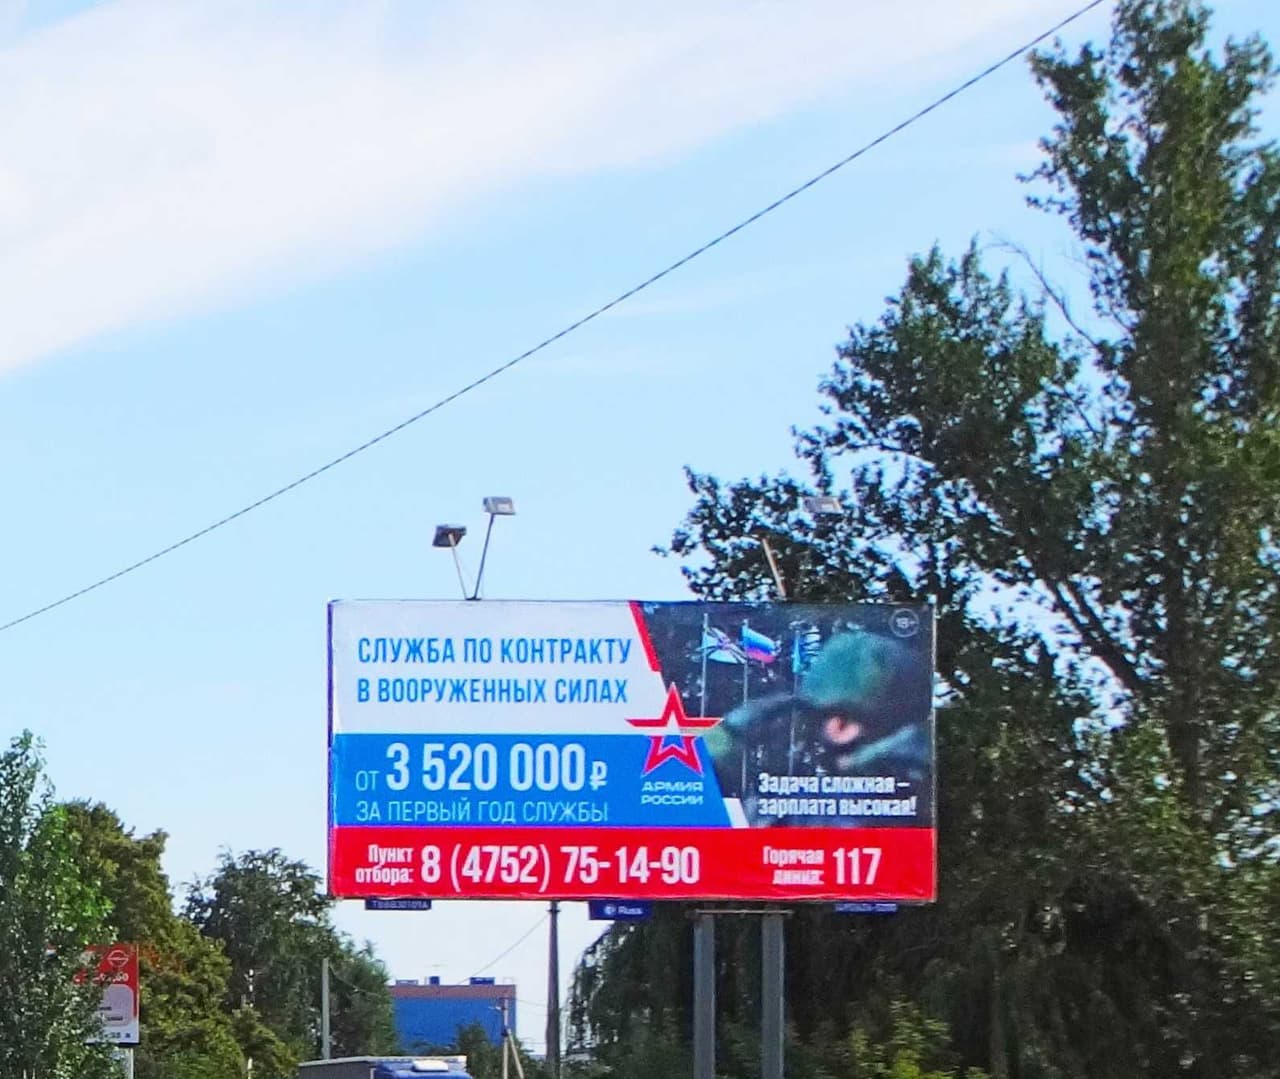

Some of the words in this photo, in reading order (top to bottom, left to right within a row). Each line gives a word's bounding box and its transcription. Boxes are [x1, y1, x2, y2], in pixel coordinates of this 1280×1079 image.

[358, 638, 455, 663] СЛУЖБА
[464, 638, 491, 663] ПО
[501, 638, 631, 663] КОНТРАКТУ
[357, 679, 370, 702] В
[378, 679, 546, 702] ВООРУЖЕННЫХ
[555, 679, 627, 702] СИЛАХ
[386, 742, 410, 791] 3
[422, 743, 498, 791] 520
[642, 781, 704, 792] АРМИЯ
[758, 773, 818, 794] Задача
[821, 776, 895, 793] сложная
[642, 795, 704, 805] РОССИИ
[758, 799, 836, 818] зарплата
[838, 797, 917, 817] высокая!
[356, 801, 381, 821] ЗА
[388, 798, 471, 821] ПЕРВЫЙ
[478, 801, 516, 824] ГОД
[522, 801, 609, 821] СЛУЖБЫ
[368, 845, 413, 865] Пункт
[763, 847, 824, 866] Горячая
[355, 866, 413, 885] отбора:
[421, 845, 440, 883] 8
[451, 844, 550, 892] (4752)
[560, 846, 700, 885] 75-14-90
[833, 848, 881, 885] 117
